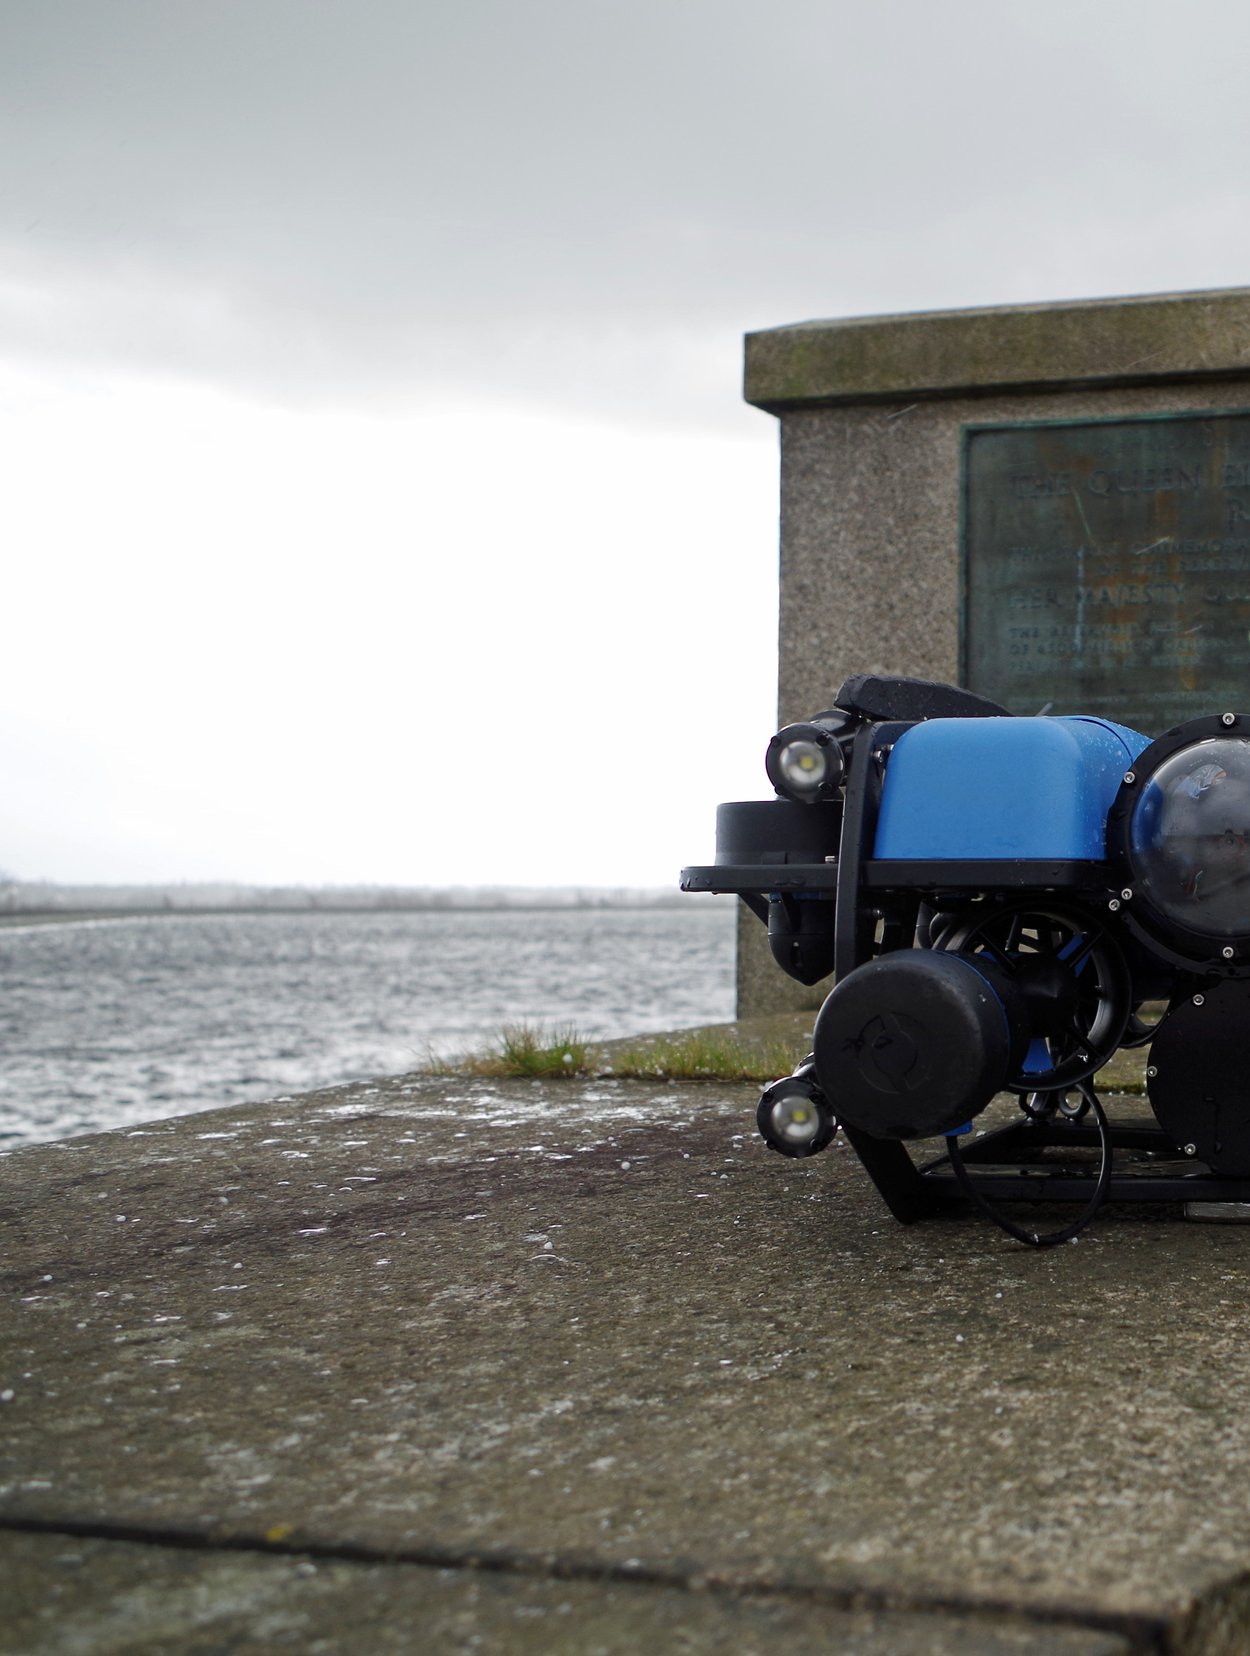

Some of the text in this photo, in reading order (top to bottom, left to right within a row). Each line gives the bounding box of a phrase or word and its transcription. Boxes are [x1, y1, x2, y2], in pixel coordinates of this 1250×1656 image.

[1009, 473, 1071, 499] THE
[1087, 464, 1199, 498] QUEEN
[1009, 587, 1062, 609] HER
[1074, 582, 1185, 608] MAJESTY
